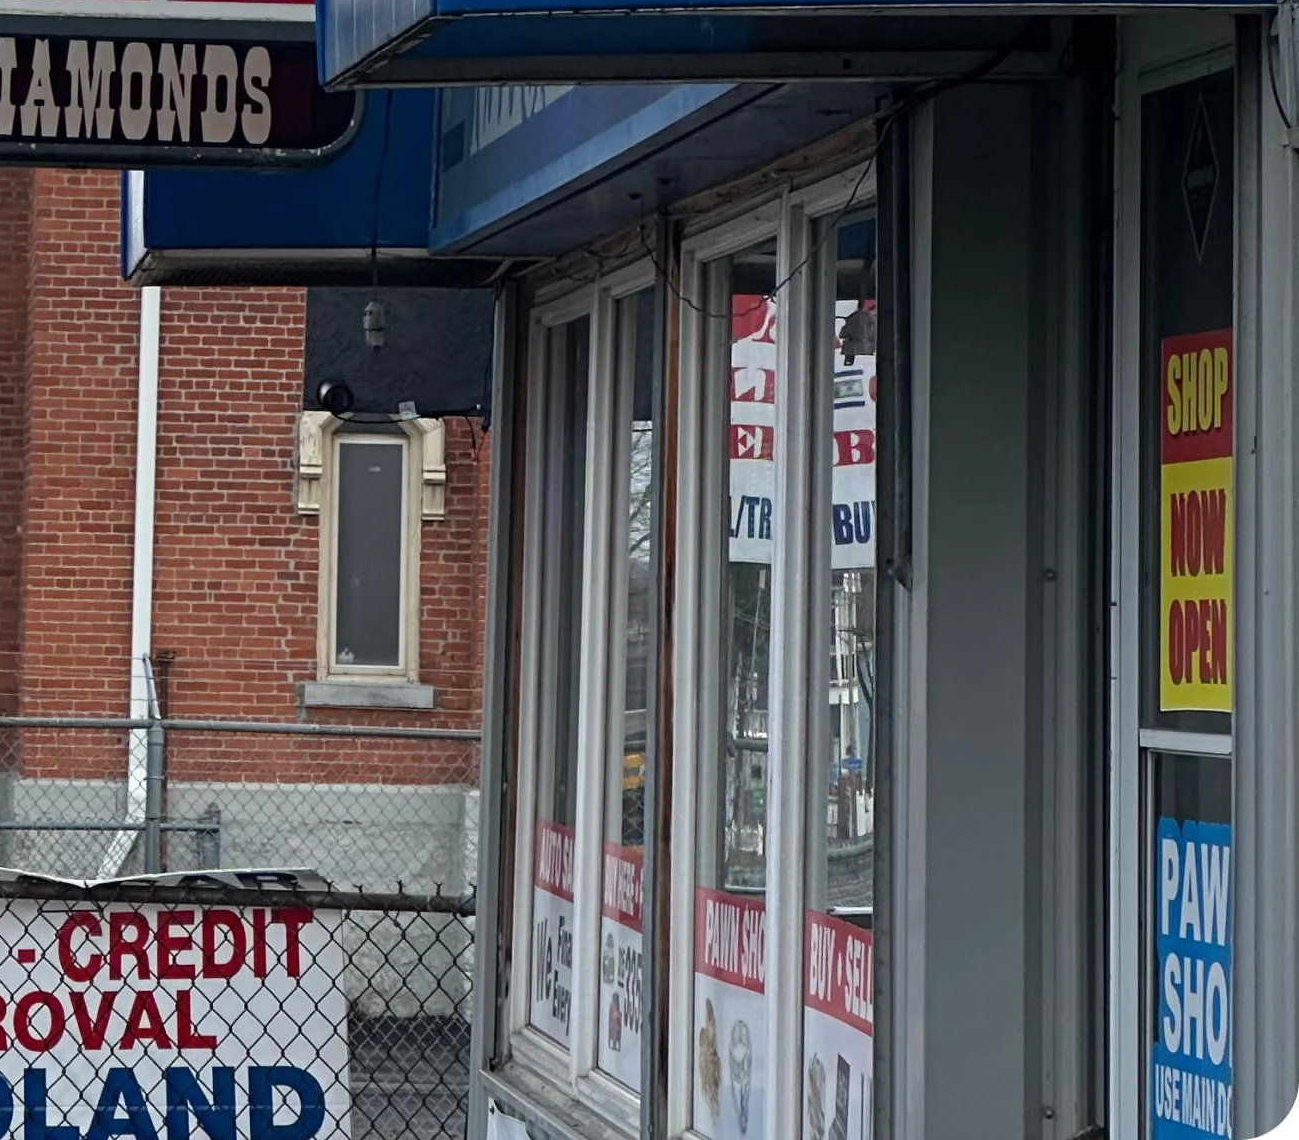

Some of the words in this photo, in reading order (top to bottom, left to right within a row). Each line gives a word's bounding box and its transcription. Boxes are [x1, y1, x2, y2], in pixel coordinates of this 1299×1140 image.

[1166, 346, 1229, 436] SHOP
[1170, 488, 1226, 578] NOW
[1168, 598, 1227, 685] OPEN
[539, 828, 562, 888] AUTO
[57, 906, 315, 982] CREDIT
[705, 899, 739, 973] PAWN
[810, 922, 835, 1002] BUY
[1163, 952, 1232, 1069] SHO
[1155, 1063, 1181, 1122] USE
[1181, 1071, 1215, 1134] MAIN
